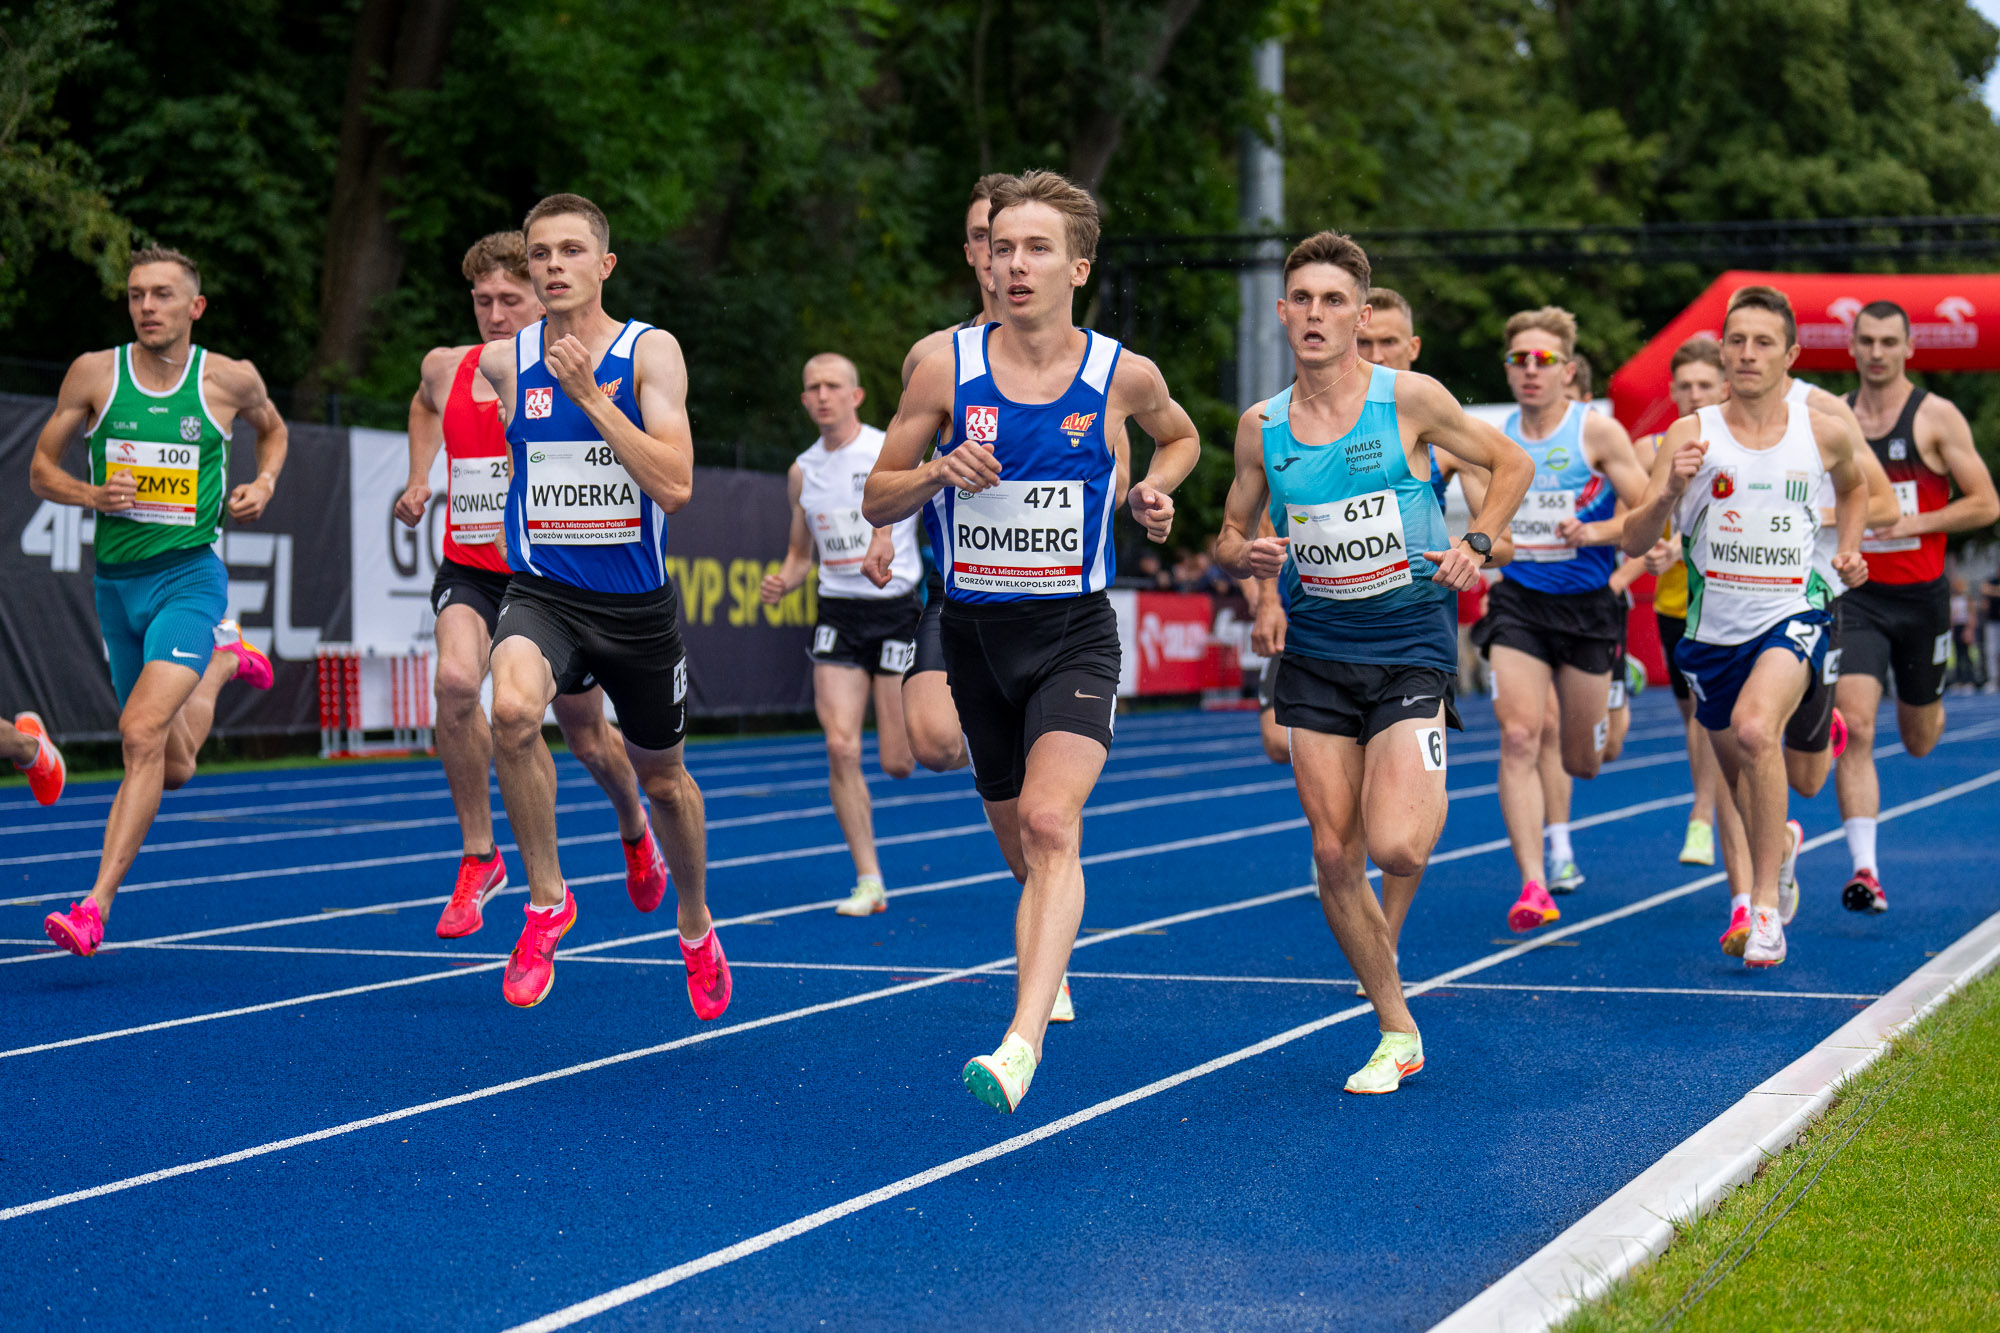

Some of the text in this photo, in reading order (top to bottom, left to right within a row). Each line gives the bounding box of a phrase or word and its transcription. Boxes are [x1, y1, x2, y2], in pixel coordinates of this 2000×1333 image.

[1060, 411, 1098, 432] AWF
[158, 449, 191, 464] 100
[1344, 439, 1382, 456] WMLKS
[1345, 451, 1383, 465] Pomorze
[136, 475, 191, 496] ZMYS
[531, 483, 635, 507] WYDERKA
[452, 491, 507, 513] KOWALC
[1023, 486, 1072, 509] 471
[1538, 494, 1567, 509] 565
[1343, 495, 1385, 522] 617
[606, 520, 627, 528] Polski
[1718, 516, 1791, 533] ORLEN 55
[533, 531, 563, 539] GORZÓW
[618, 530, 636, 538] 2023
[824, 534, 866, 552] KULIK
[958, 523, 1078, 553] ROMBERG
[1294, 532, 1402, 565] KOMODA
[1710, 540, 1801, 566] WIŚNIEWSKI
[968, 565, 1066, 576] 99. PZLA Mistrzostwa Polski
[1335, 574, 1376, 585] Mistrzostwa
[1376, 566, 1395, 577] Polski
[958, 576, 1076, 588] GORZÓW WIELKOPOLSKI 2023
[1307, 572, 1407, 594] GORZÓW WIELKOPOLSKI 2023
[1427, 729, 1443, 767] 6
